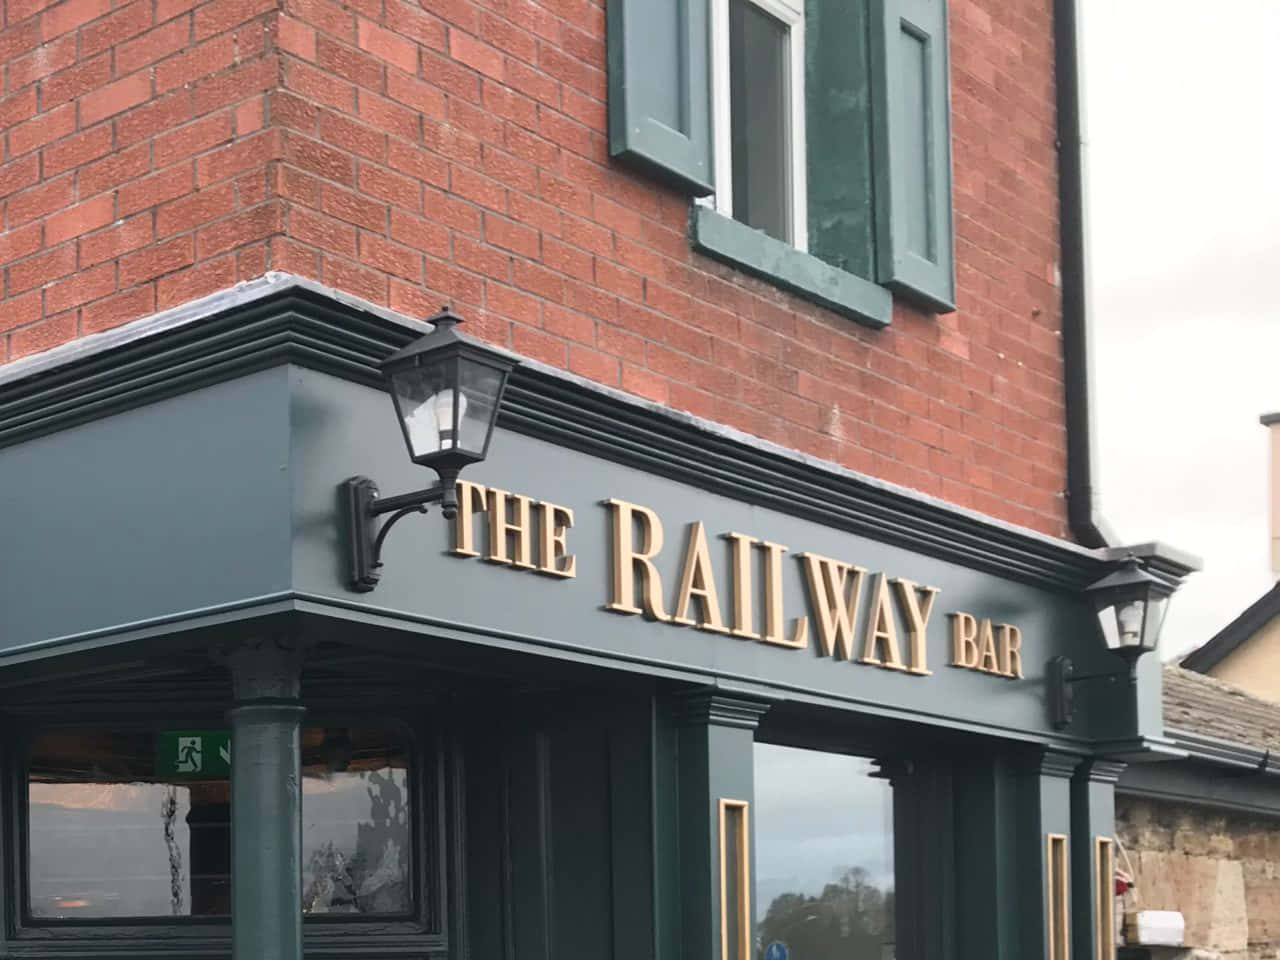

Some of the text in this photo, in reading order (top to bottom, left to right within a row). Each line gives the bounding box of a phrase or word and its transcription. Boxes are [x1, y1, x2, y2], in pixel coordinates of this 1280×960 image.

[449, 480, 1025, 679] THE RAILWAY BAR
